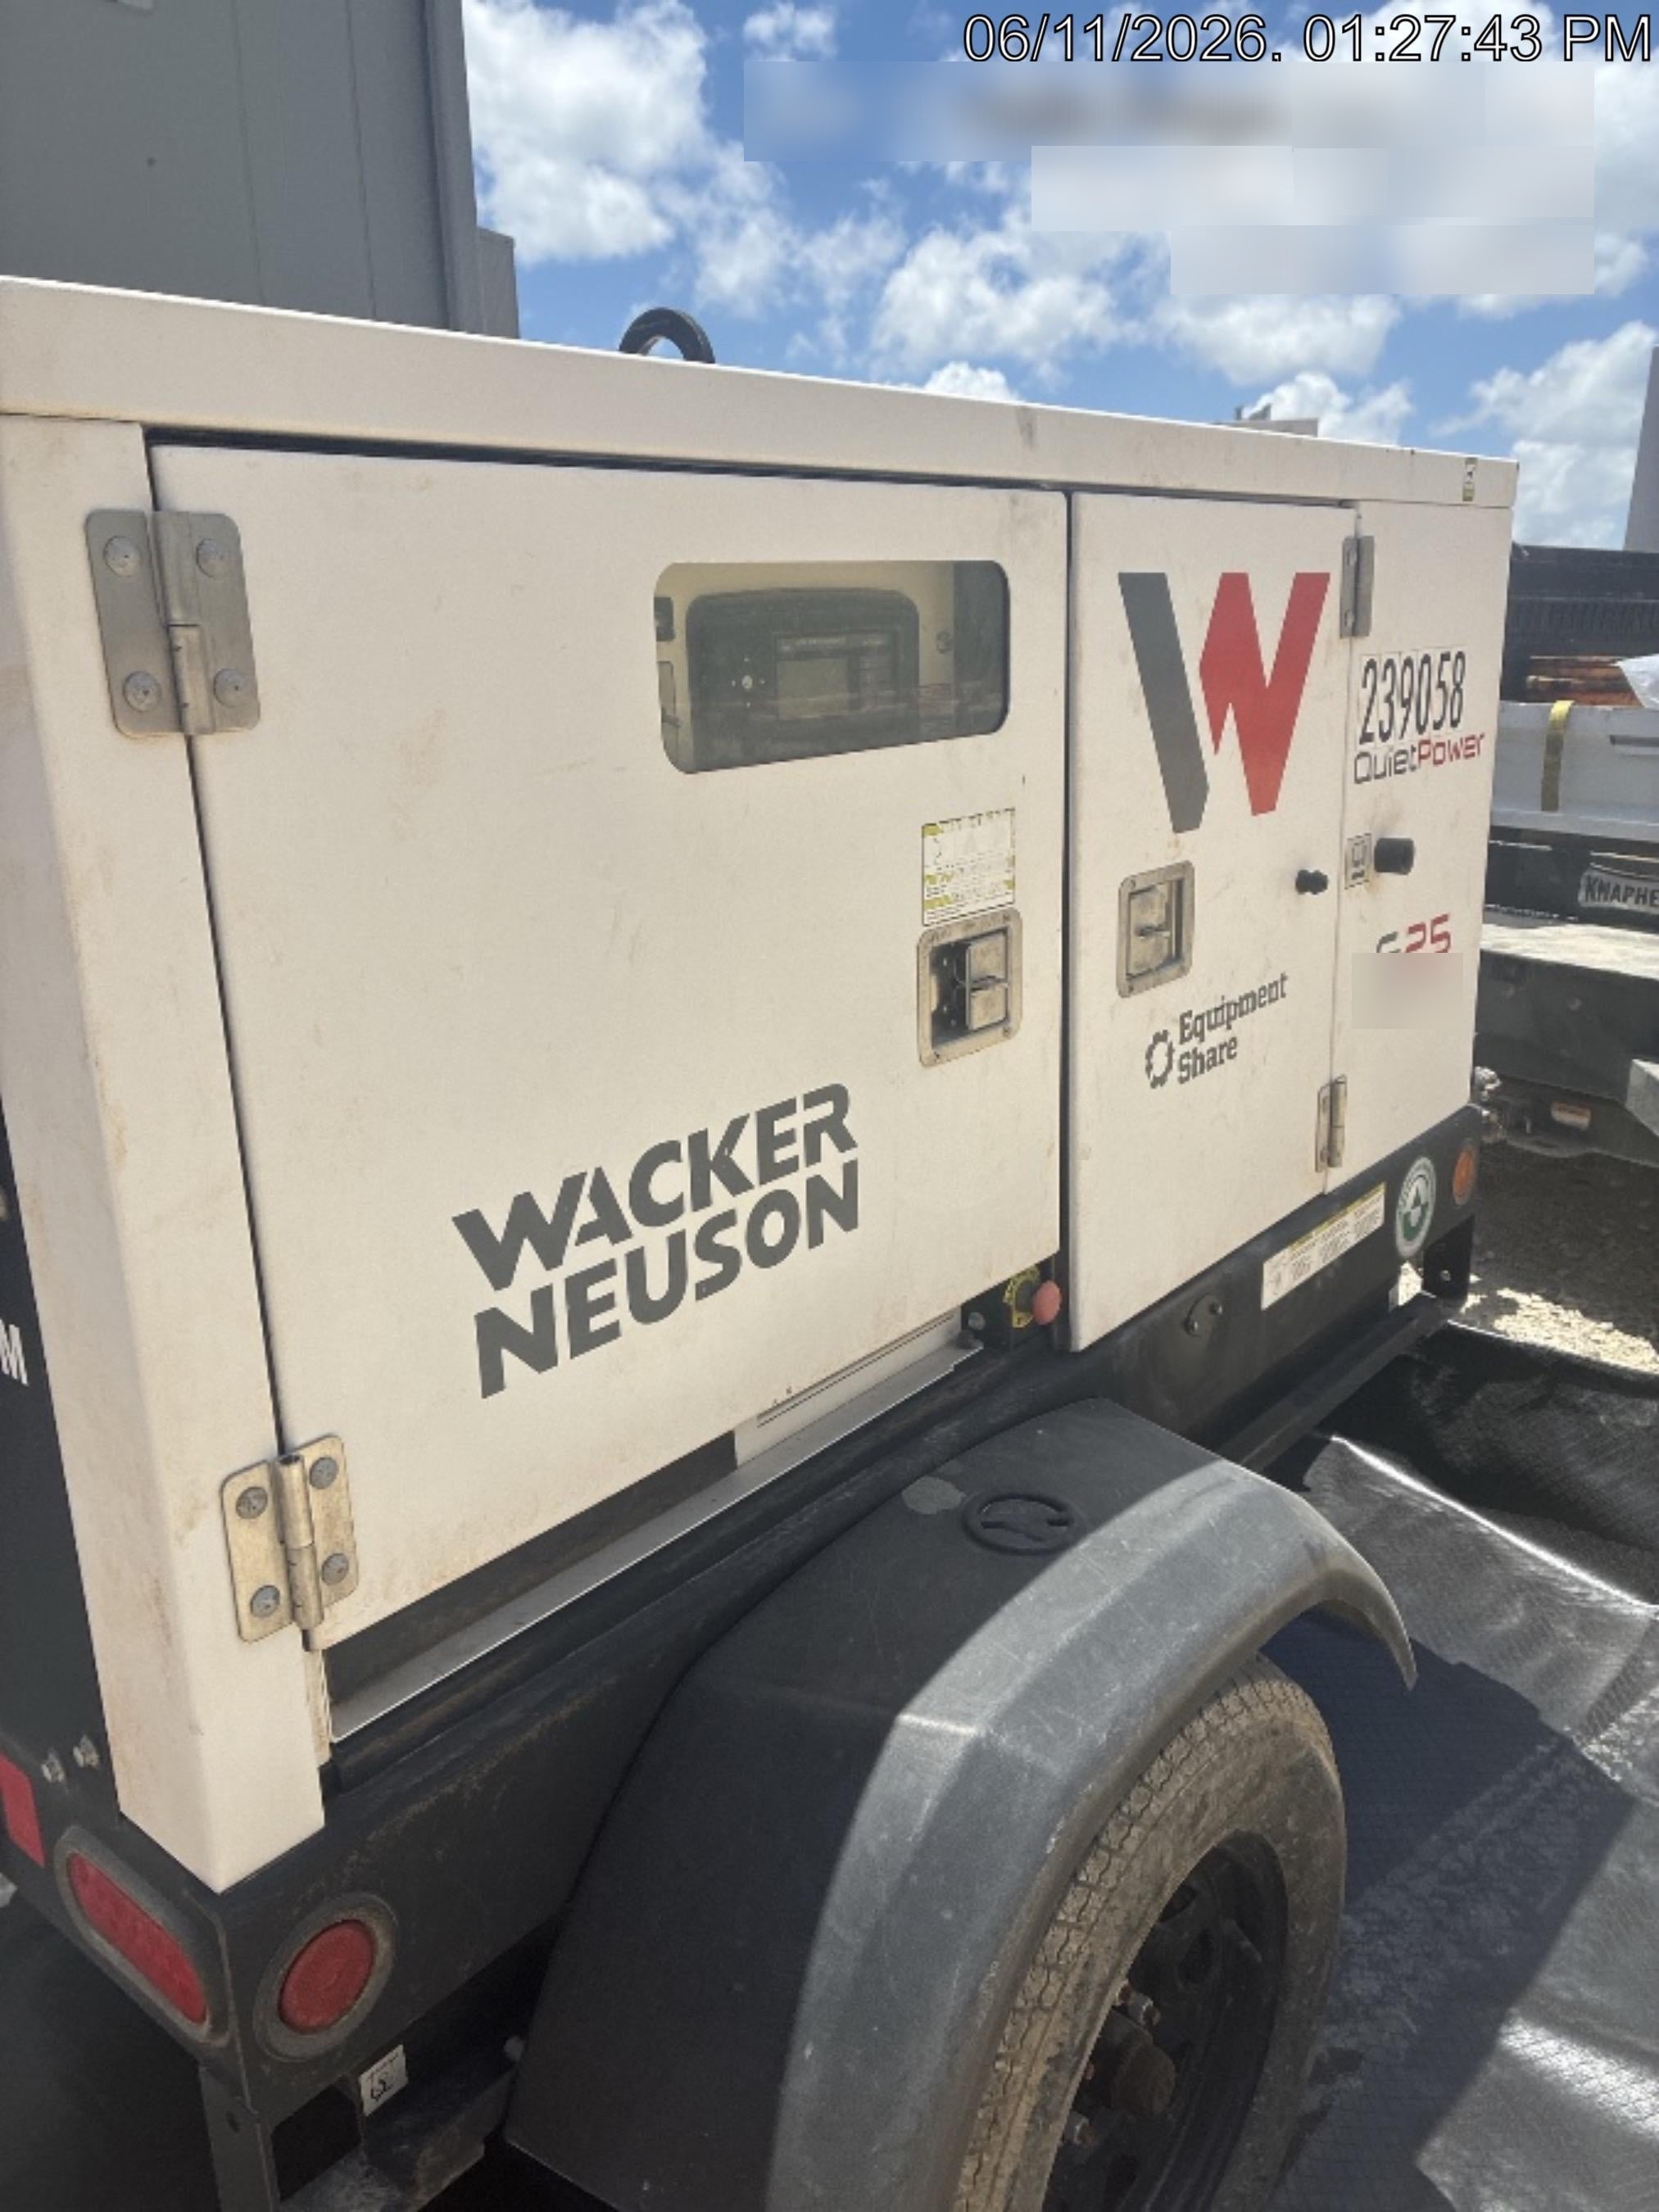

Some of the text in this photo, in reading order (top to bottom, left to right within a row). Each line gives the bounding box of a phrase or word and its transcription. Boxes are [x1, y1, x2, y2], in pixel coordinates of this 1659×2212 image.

[1359, 651, 1466, 744] 239058
[1353, 733, 1485, 784] QuietPower
[1179, 971, 1289, 1045] Equipment
[1177, 1036, 1238, 1085] Share
[451, 1083, 859, 1291] WACKER
[474, 1158, 859, 1399] NEUSON
